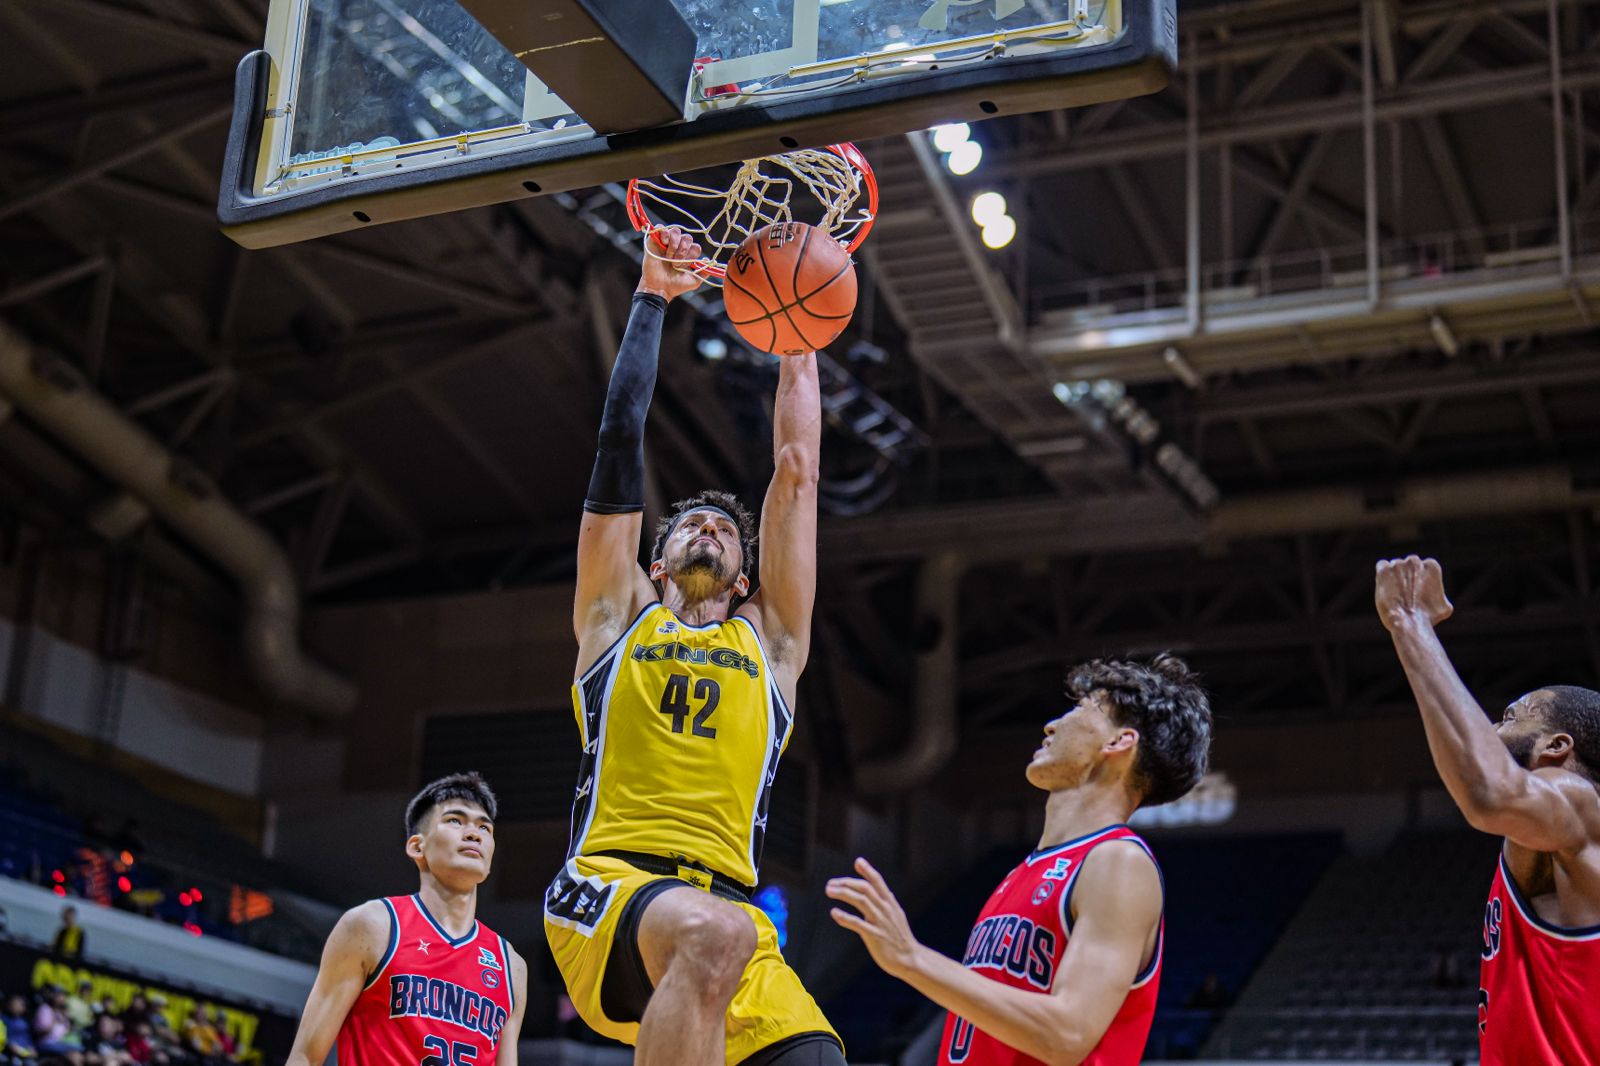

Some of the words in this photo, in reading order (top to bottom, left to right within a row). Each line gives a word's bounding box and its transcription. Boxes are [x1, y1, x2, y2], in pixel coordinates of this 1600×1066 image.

[631, 641, 759, 679] KINGS
[660, 674, 721, 739] 42
[389, 974, 507, 1050] BRONCOS
